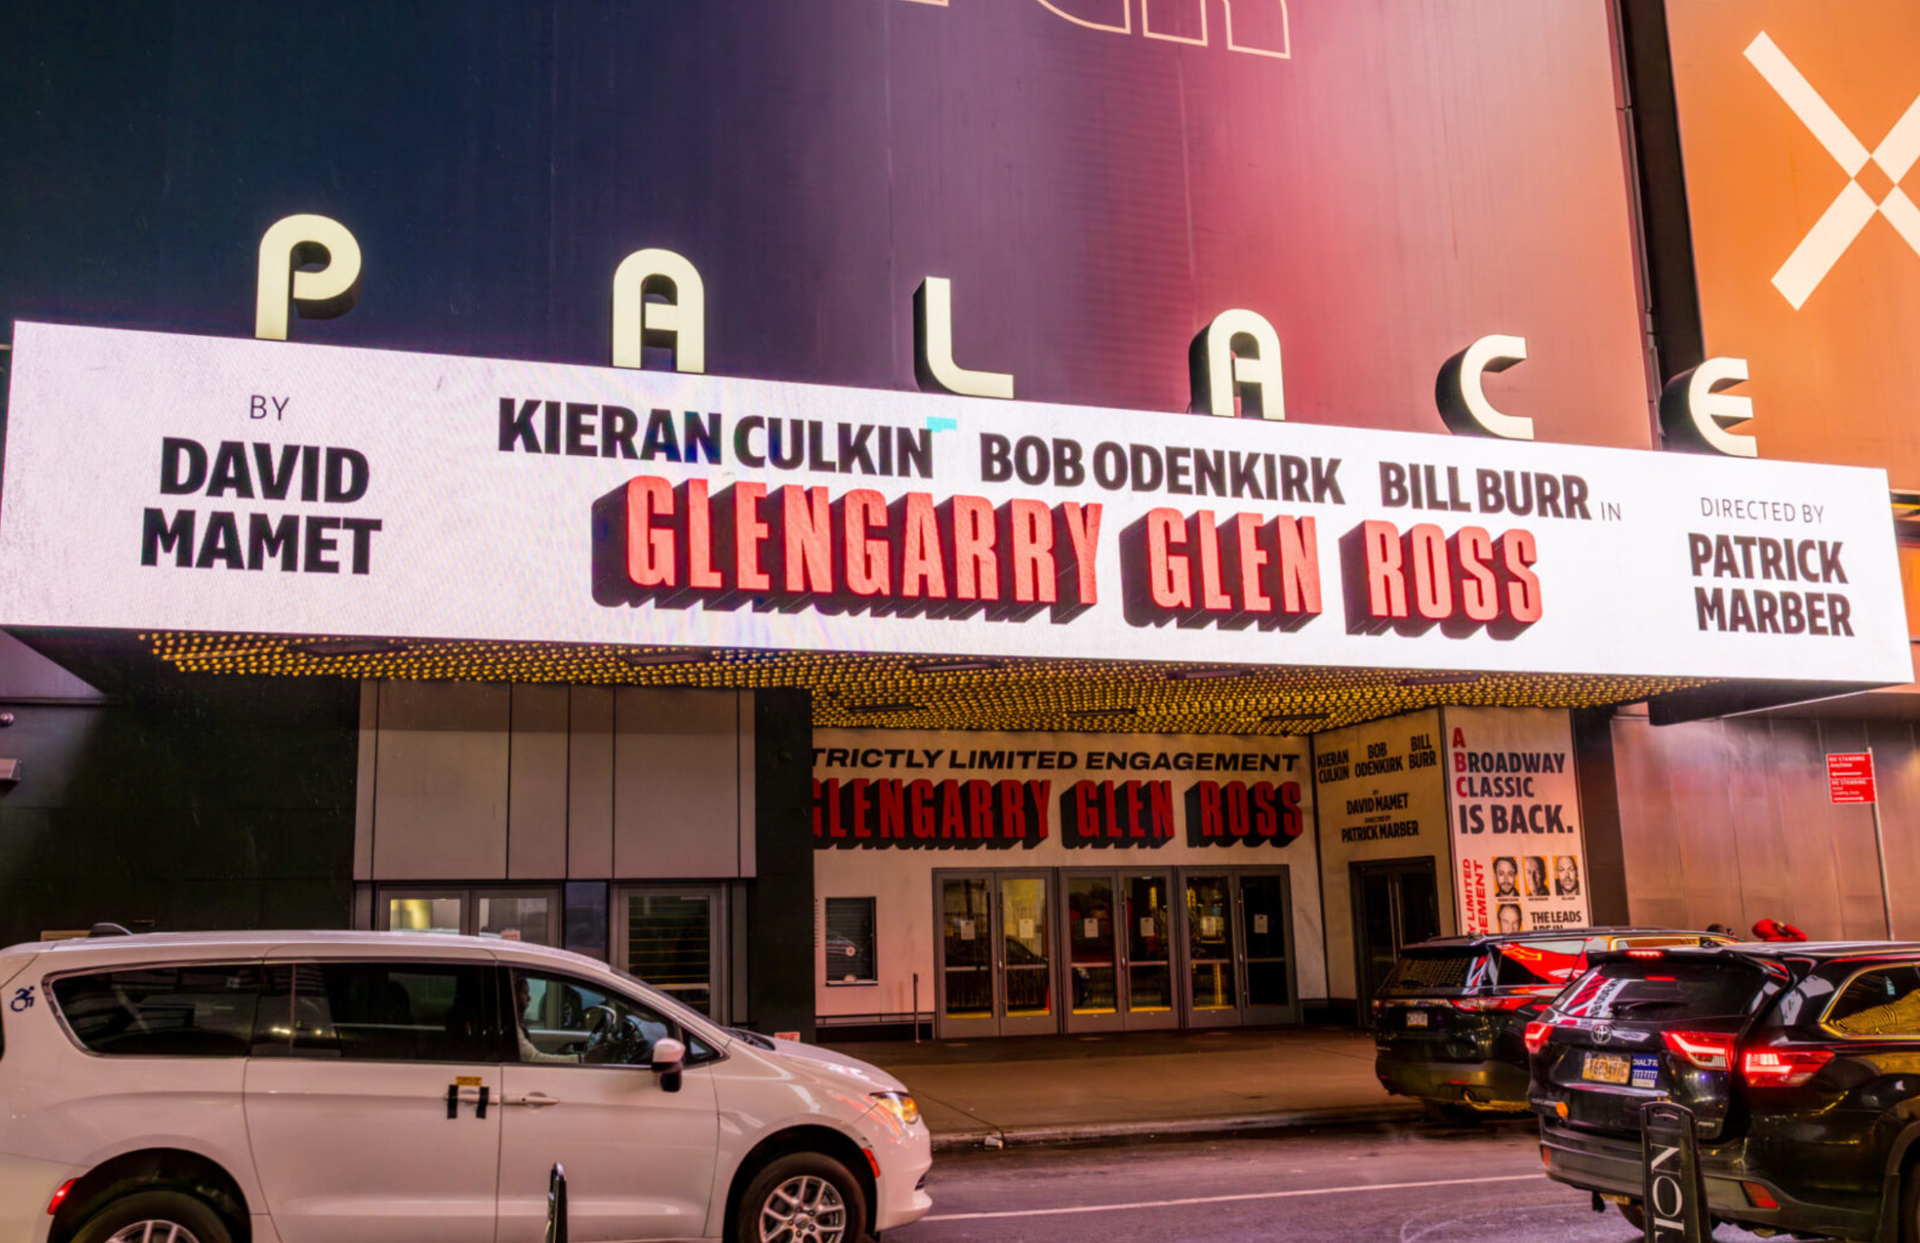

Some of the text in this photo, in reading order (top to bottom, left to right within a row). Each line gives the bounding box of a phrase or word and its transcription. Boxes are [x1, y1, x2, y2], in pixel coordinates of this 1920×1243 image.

[255, 213, 1758, 457] PALACE
[249, 395, 290, 421] BY
[159, 436, 370, 503] DAVID
[499, 397, 1622, 521] KIERAN CULKIN BOB ODENKIRK BILL BURR IN
[1700, 497, 1824, 524] DIRECTED BY
[140, 507, 382, 575] MAMET
[626, 475, 1543, 622] GLENGARRY GLEN ROSS
[1688, 532, 1849, 584] PATRICK
[1694, 586, 1855, 637] MARBER
[1411, 734, 1432, 751] BILL
[1452, 727, 1466, 748] A
[812, 748, 1301, 772] TRICTLY LIMITED ENGAGEMENT
[1317, 749, 1349, 769] KIERAN
[1367, 742, 1387, 759] BOB
[1409, 750, 1437, 769] BURR
[1454, 751, 1565, 773] BROADWAY
[1318, 765, 1349, 784] CULKIN
[1355, 756, 1403, 777] ODENKIRK
[1456, 776, 1534, 798] CLASSIC
[1076, 779, 1175, 837] GLEN
[1200, 780, 1303, 836] ROSS
[1346, 792, 1408, 815] DAVID MAMET
[1341, 820, 1419, 843] PATRICK MARBER
[1459, 804, 1574, 834] IS BACK.
[1463, 858, 1475, 921] LIMITED
[1530, 910, 1582, 923] THE LEADS
[1650, 1138, 1685, 1243] ION
